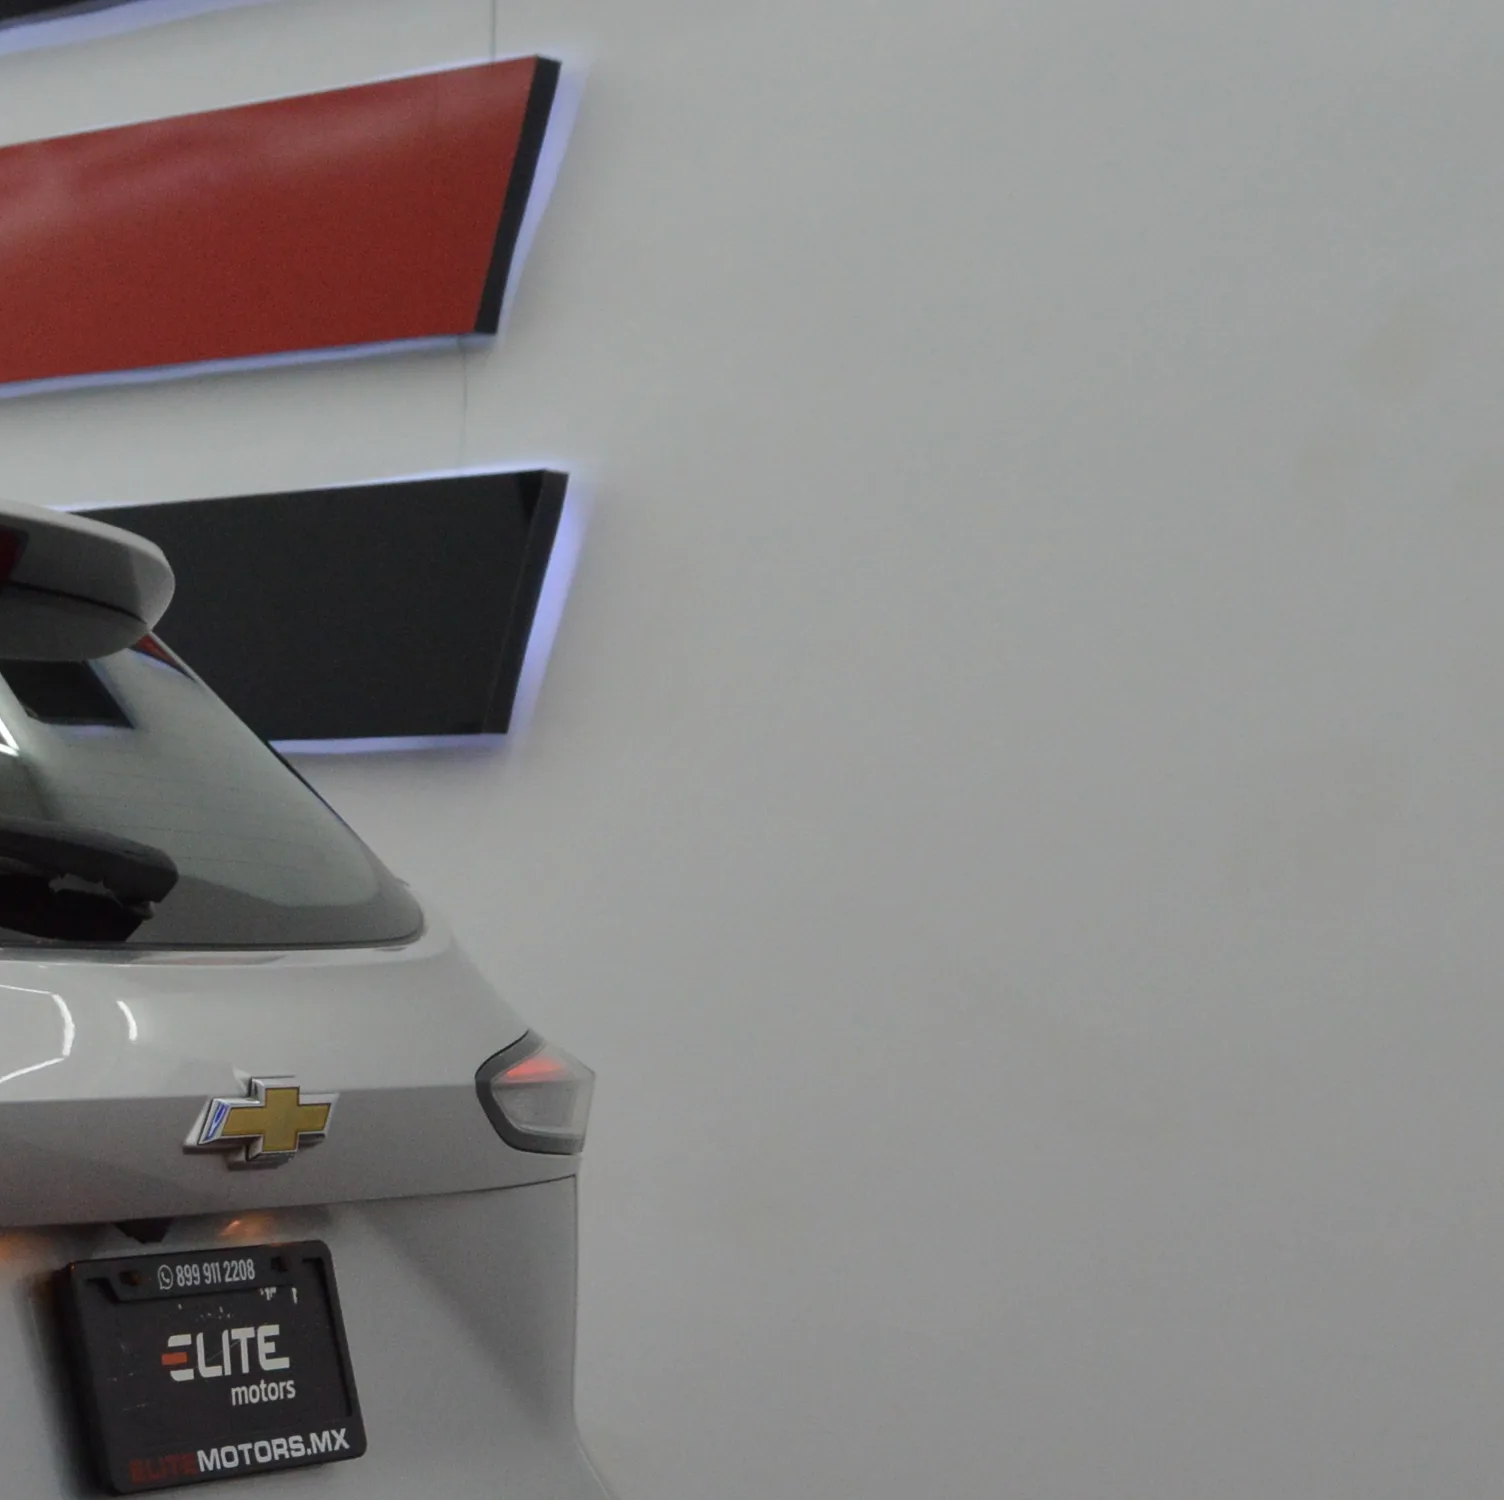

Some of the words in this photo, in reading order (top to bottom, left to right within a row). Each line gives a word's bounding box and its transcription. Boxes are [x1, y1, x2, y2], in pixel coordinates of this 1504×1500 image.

[175, 1263, 201, 1287] 899
[203, 1262, 222, 1285] 911
[223, 1258, 256, 1283] 2208
[161, 1324, 291, 1382] ELITE
[231, 1379, 296, 1406] motors
